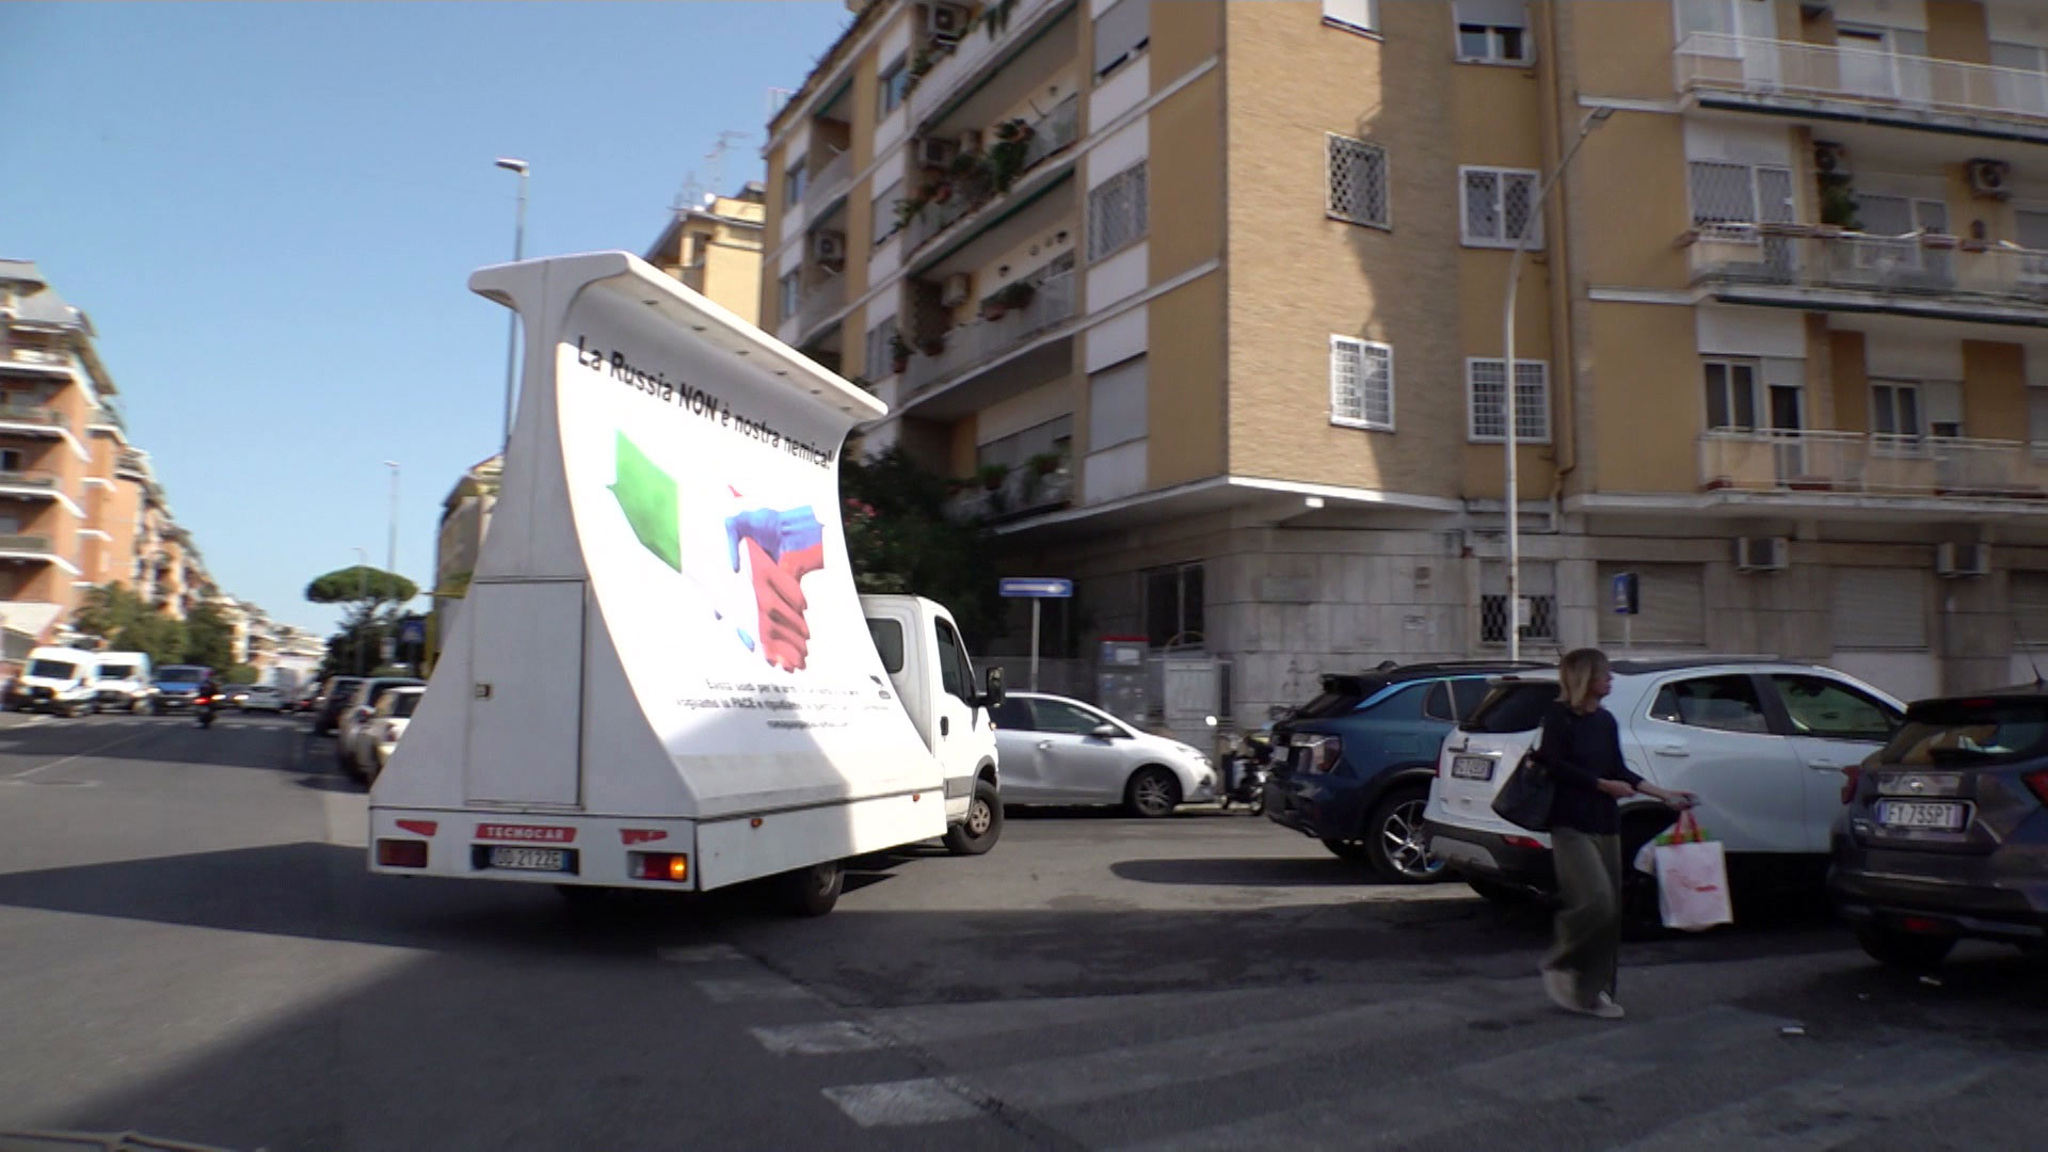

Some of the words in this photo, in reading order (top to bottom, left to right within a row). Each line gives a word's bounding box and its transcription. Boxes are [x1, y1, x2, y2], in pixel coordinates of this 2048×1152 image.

[577, 335, 602, 371] La
[610, 351, 674, 402] Russia
[678, 383, 718, 422] NON
[720, 402, 730, 427] è
[734, 415, 781, 448] nostra
[783, 433, 835, 470] nemica!
